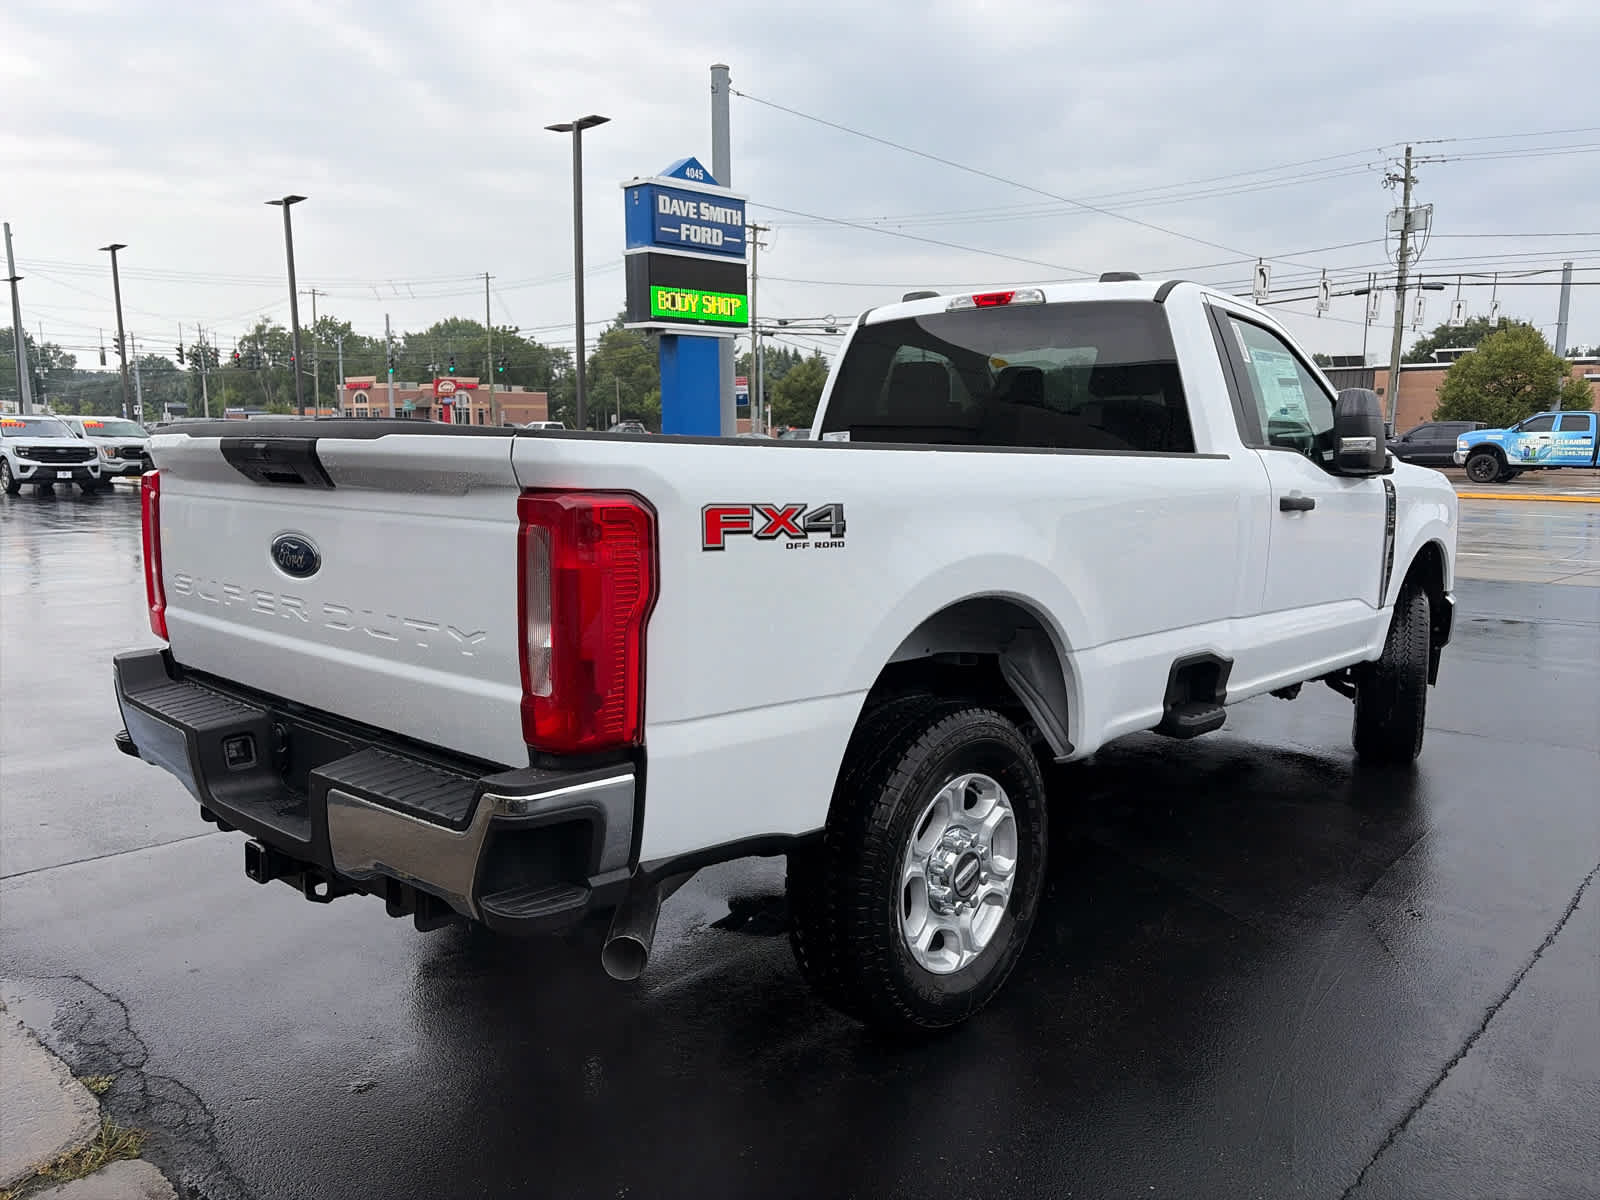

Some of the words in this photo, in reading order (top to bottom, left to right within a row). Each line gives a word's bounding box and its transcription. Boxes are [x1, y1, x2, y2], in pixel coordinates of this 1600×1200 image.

[685, 167, 704, 180] 4045
[658, 194, 698, 219] DAVE
[699, 202, 742, 226] SMITH
[680, 223, 723, 246] FORD
[657, 290, 699, 313] BODY
[702, 295, 741, 316] SHOP
[701, 503, 846, 551] FX4
[786, 542, 810, 550] OFF
[814, 541, 845, 549] ROAD
[174, 573, 309, 623] SUPER
[322, 602, 486, 656] DUTY
